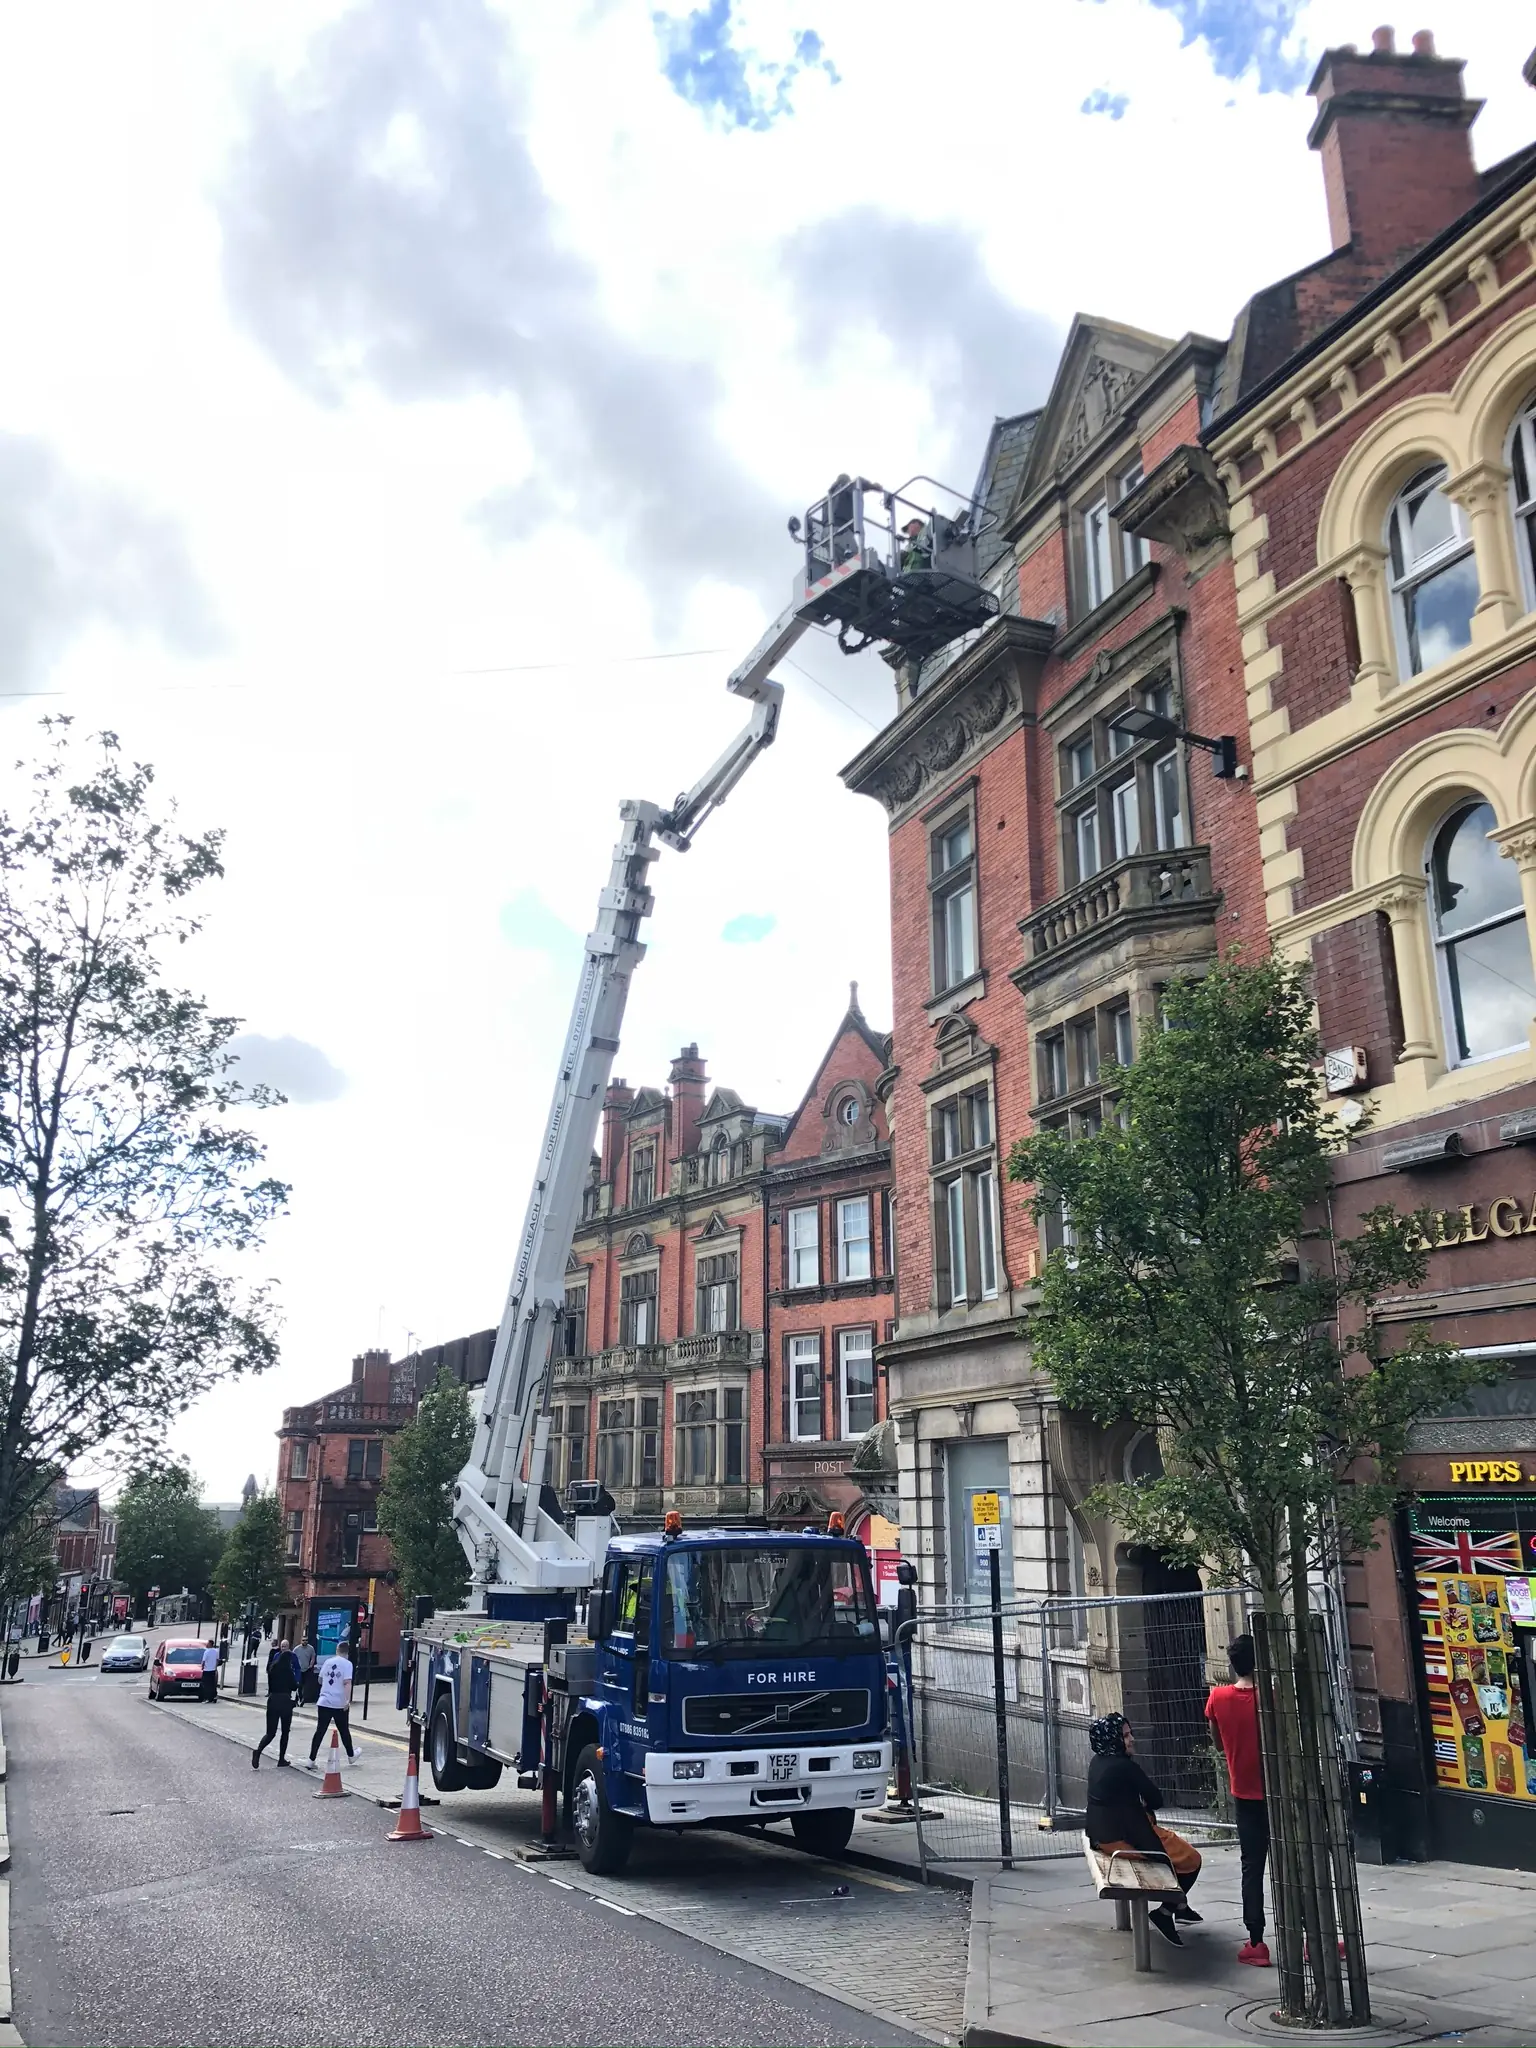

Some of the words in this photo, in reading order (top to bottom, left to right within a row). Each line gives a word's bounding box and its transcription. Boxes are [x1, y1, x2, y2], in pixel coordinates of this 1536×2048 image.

[545, 1133, 555, 1161] FOR
[552, 1101, 564, 1131] HIRE
[517, 1251, 529, 1283] HIGH
[524, 1203, 541, 1246] REACH
[814, 1461, 845, 1473] POST
[1449, 1460, 1522, 1483] PIPES
[1428, 1516, 1471, 1527] Welcome
[747, 1673, 777, 1684] FOR
[783, 1671, 816, 1682] HIRE
[769, 1754, 797, 1767] YE52
[772, 1768, 793, 1780] HJF
